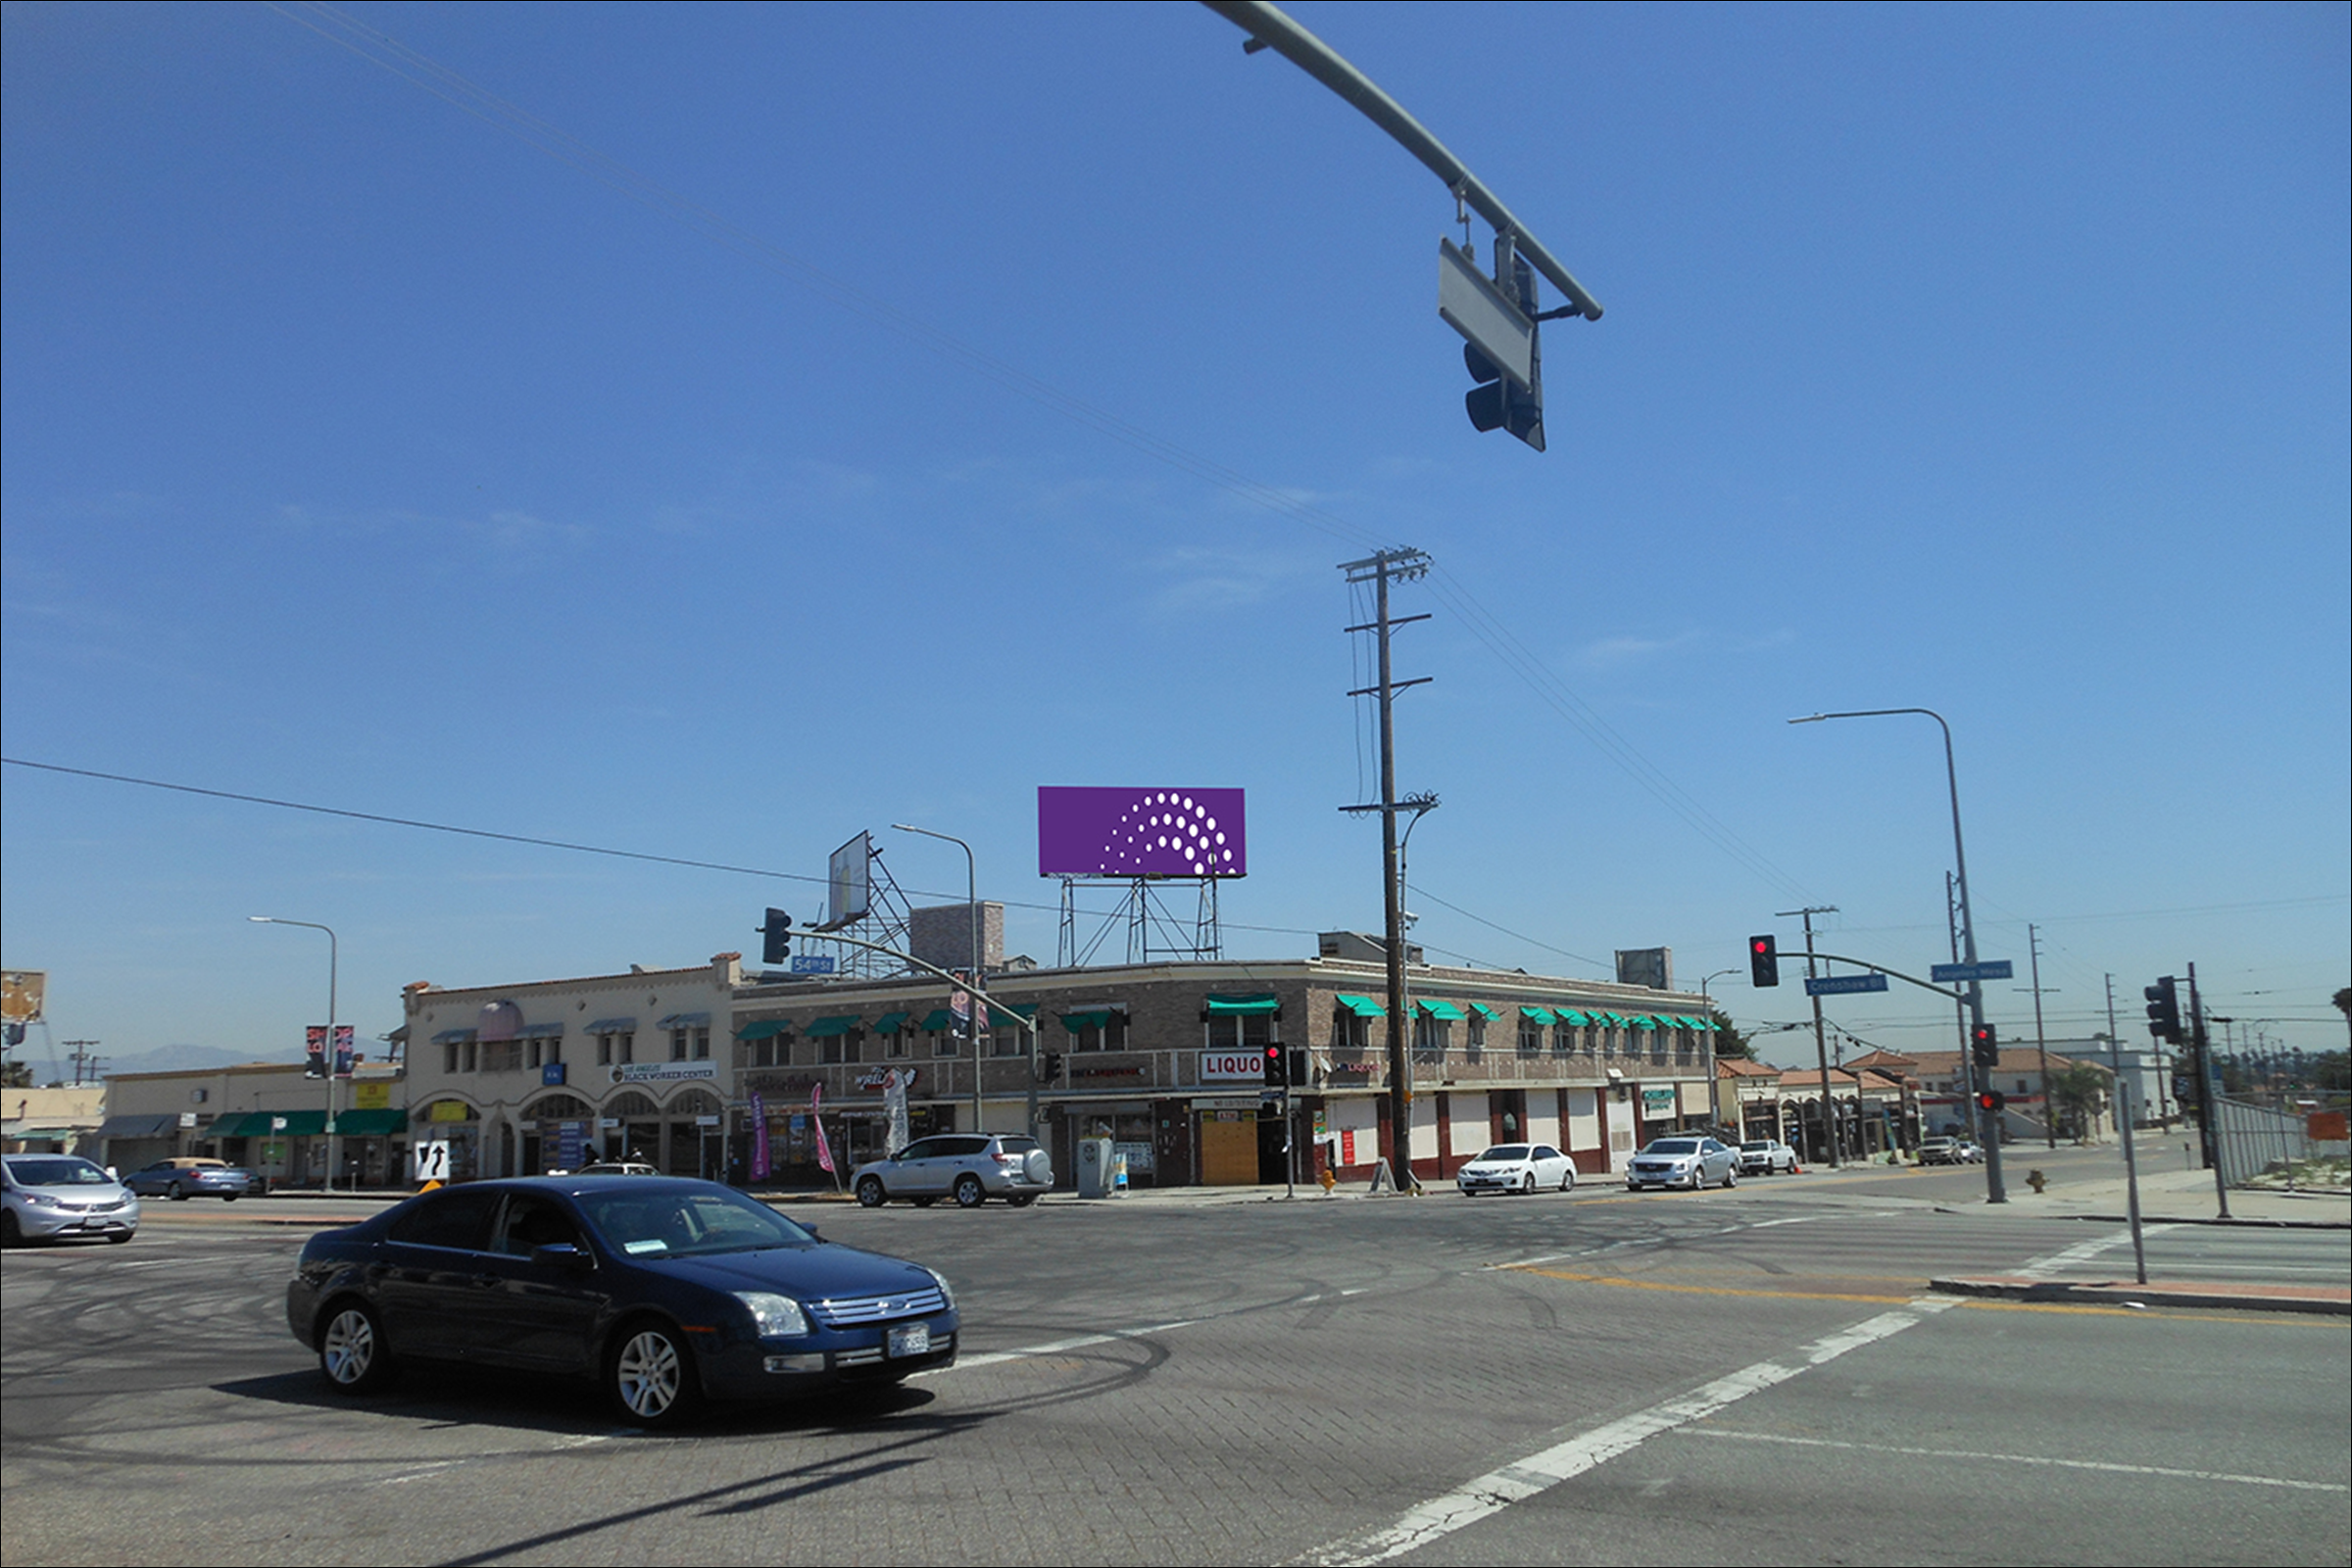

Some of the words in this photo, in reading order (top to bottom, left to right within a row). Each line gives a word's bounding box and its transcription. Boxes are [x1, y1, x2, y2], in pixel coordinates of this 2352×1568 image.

[1811, 980, 1867, 992] Crenshaw
[1206, 1056, 1262, 1073] LIQUO
[683, 1069, 713, 1079] CENTER
